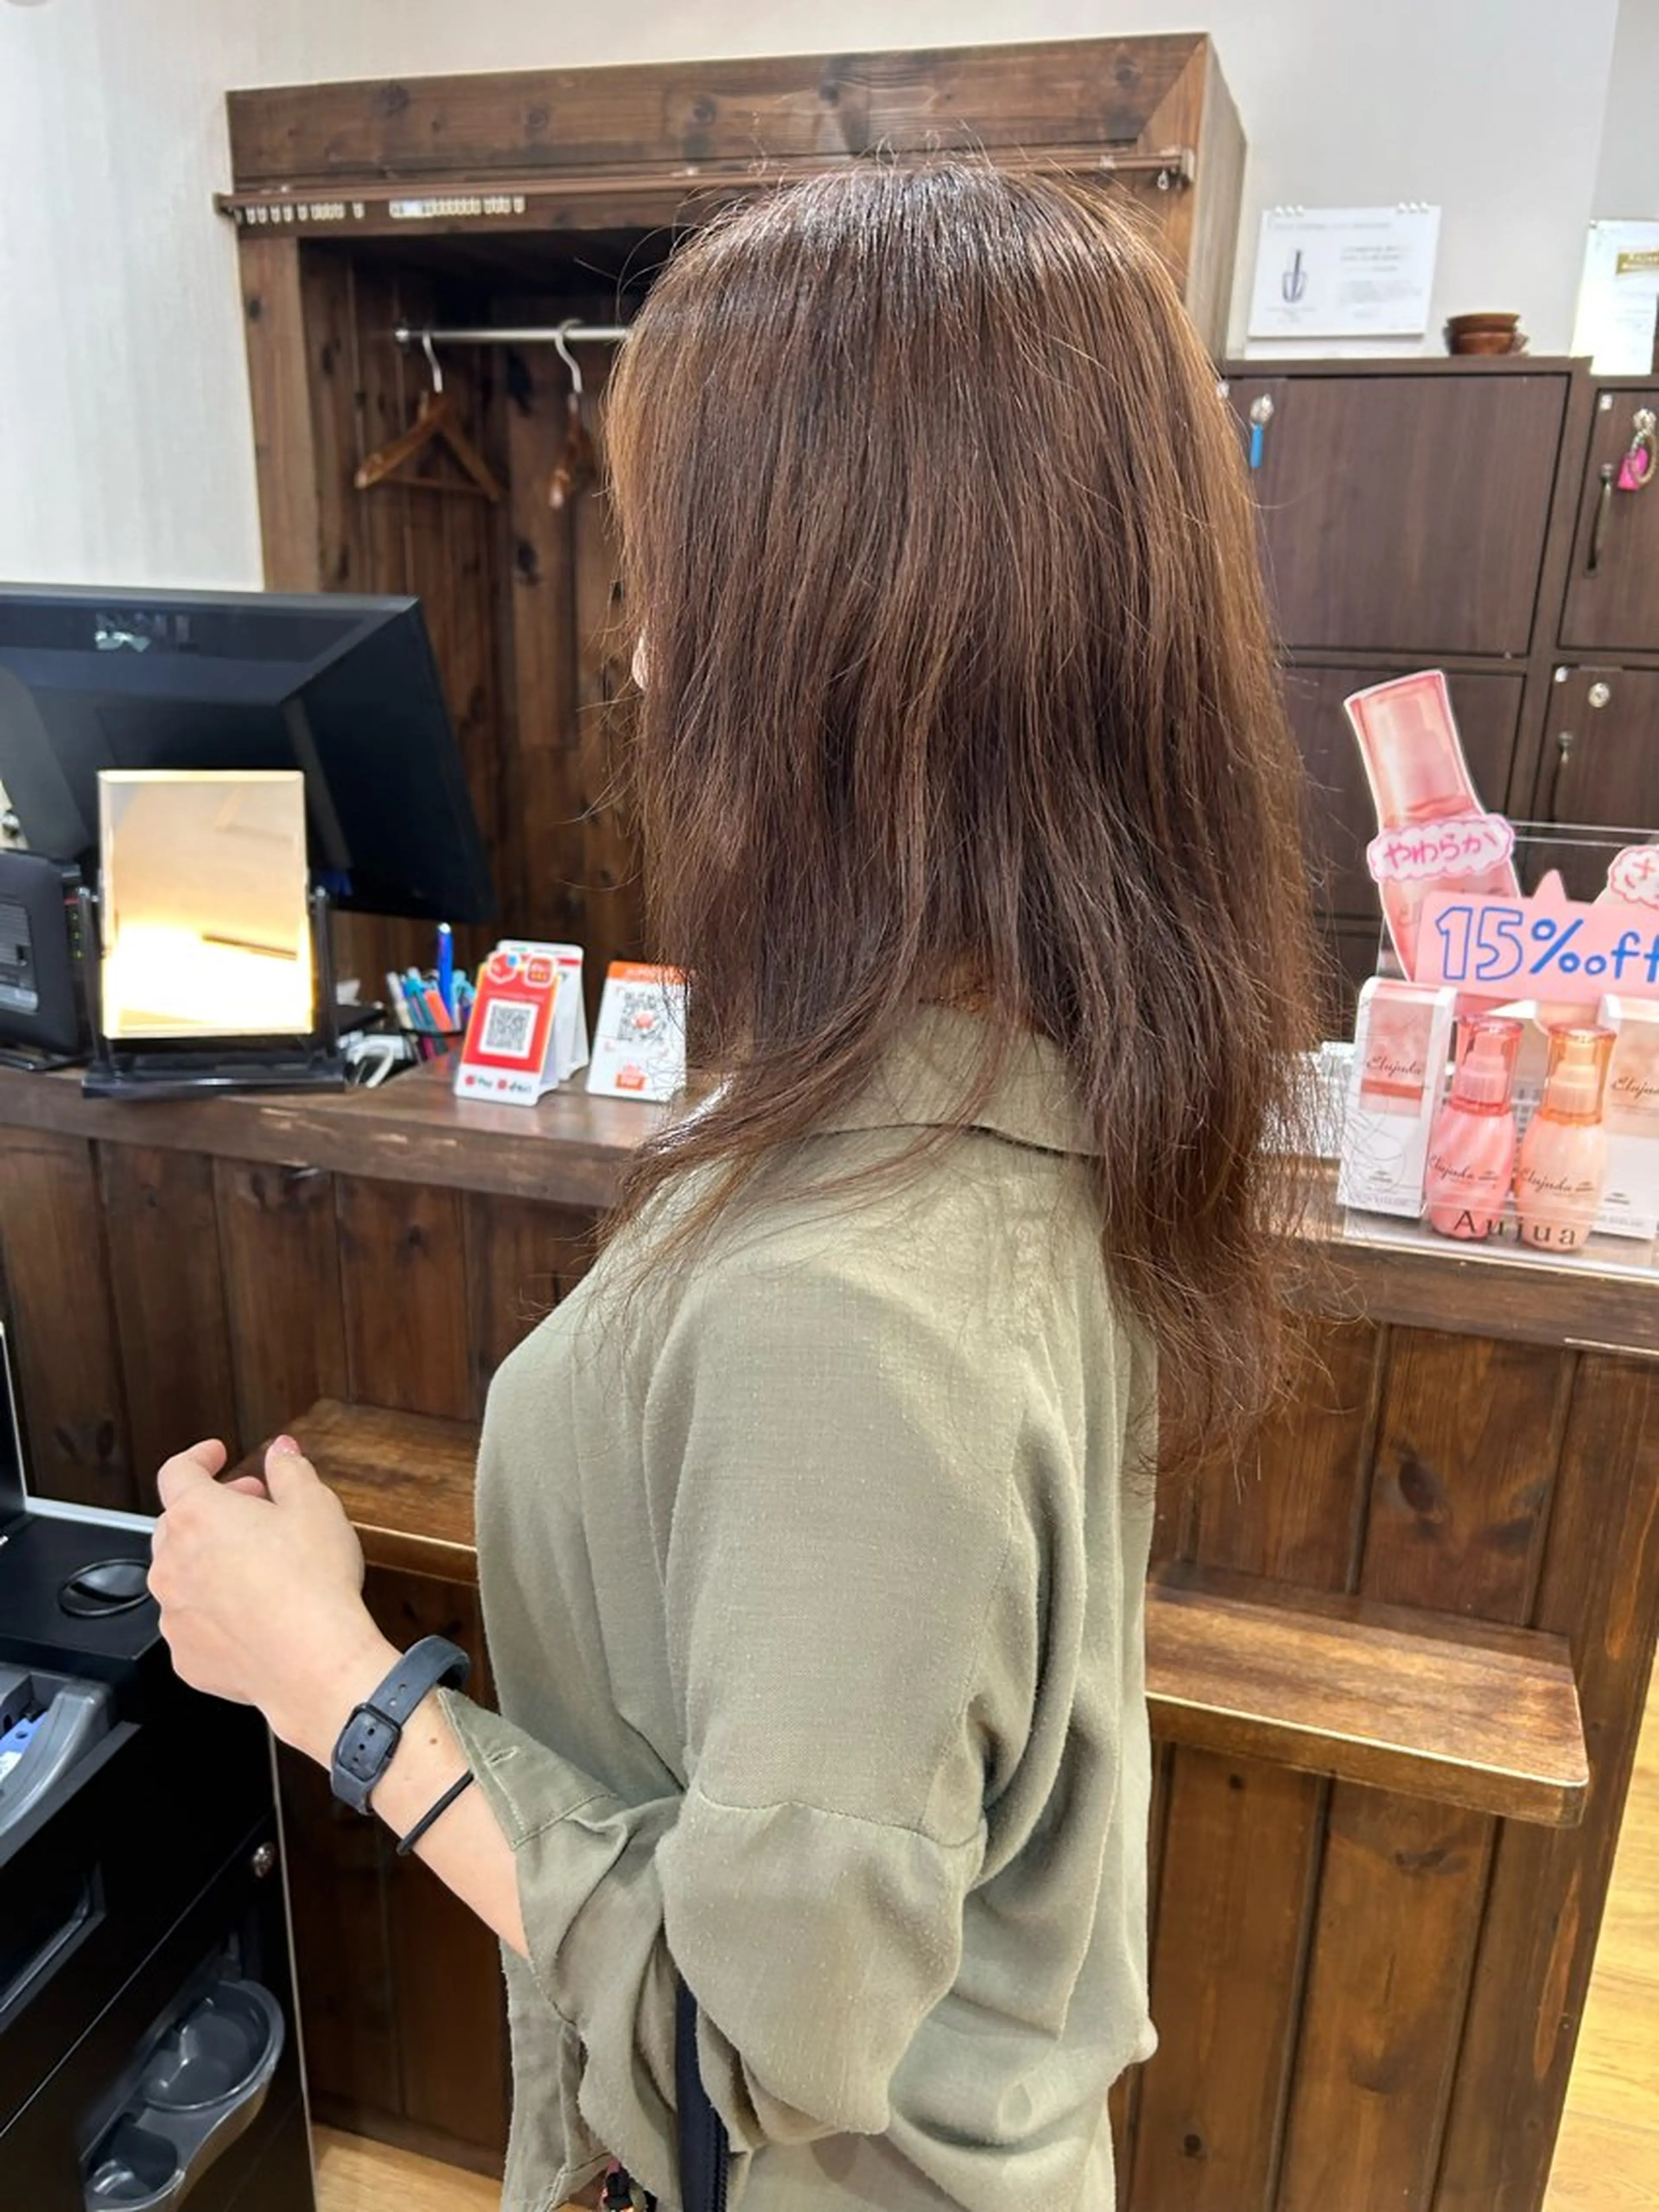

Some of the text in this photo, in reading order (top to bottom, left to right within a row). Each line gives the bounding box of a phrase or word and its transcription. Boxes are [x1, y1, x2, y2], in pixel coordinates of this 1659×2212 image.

[1385, 833, 1497, 869] やわらか
[1454, 1210, 1576, 1246] Aujua
